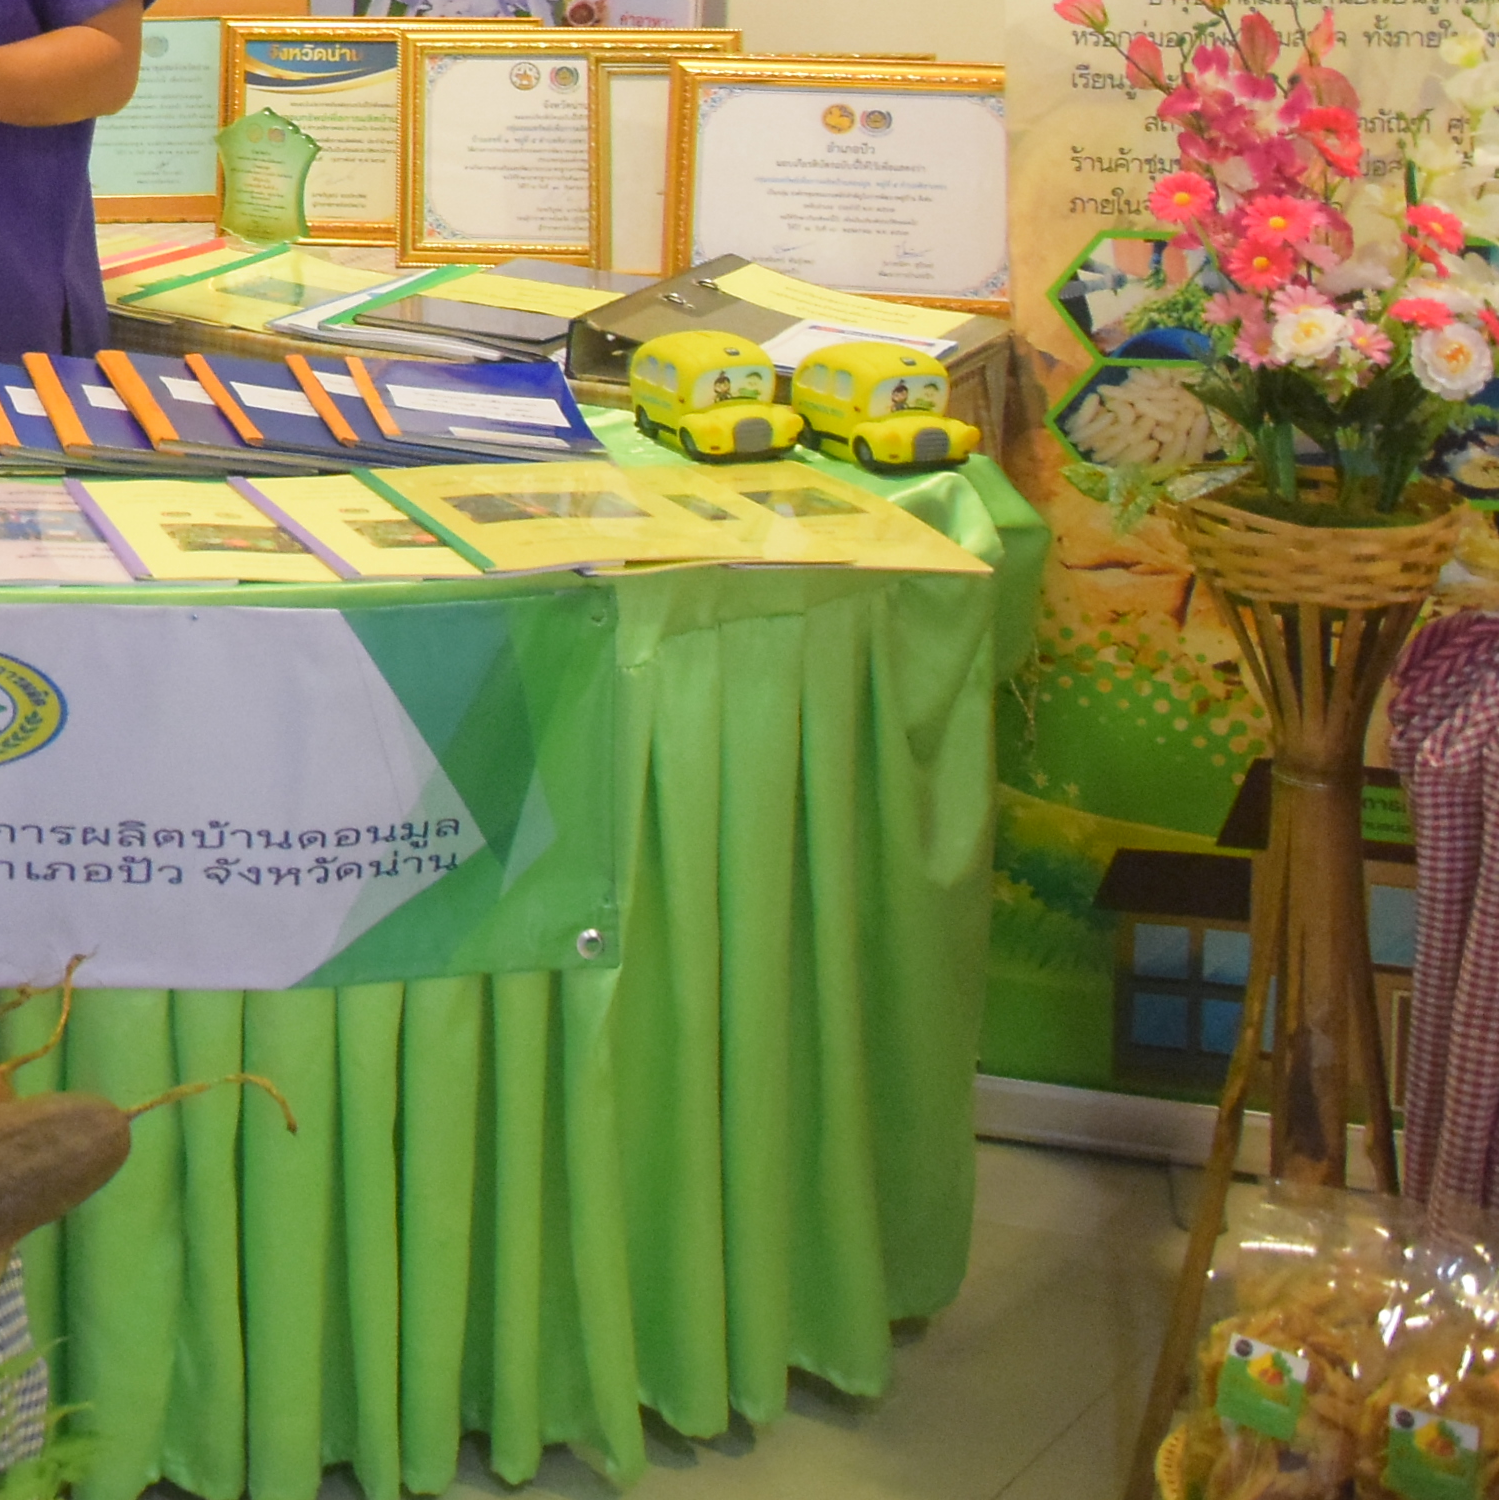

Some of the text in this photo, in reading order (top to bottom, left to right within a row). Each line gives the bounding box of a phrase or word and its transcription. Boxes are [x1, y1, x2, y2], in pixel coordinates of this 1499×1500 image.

[267, 43, 363, 63] จังหวัดน่าน
[203, 845, 461, 887] จังหวัดน่าน
